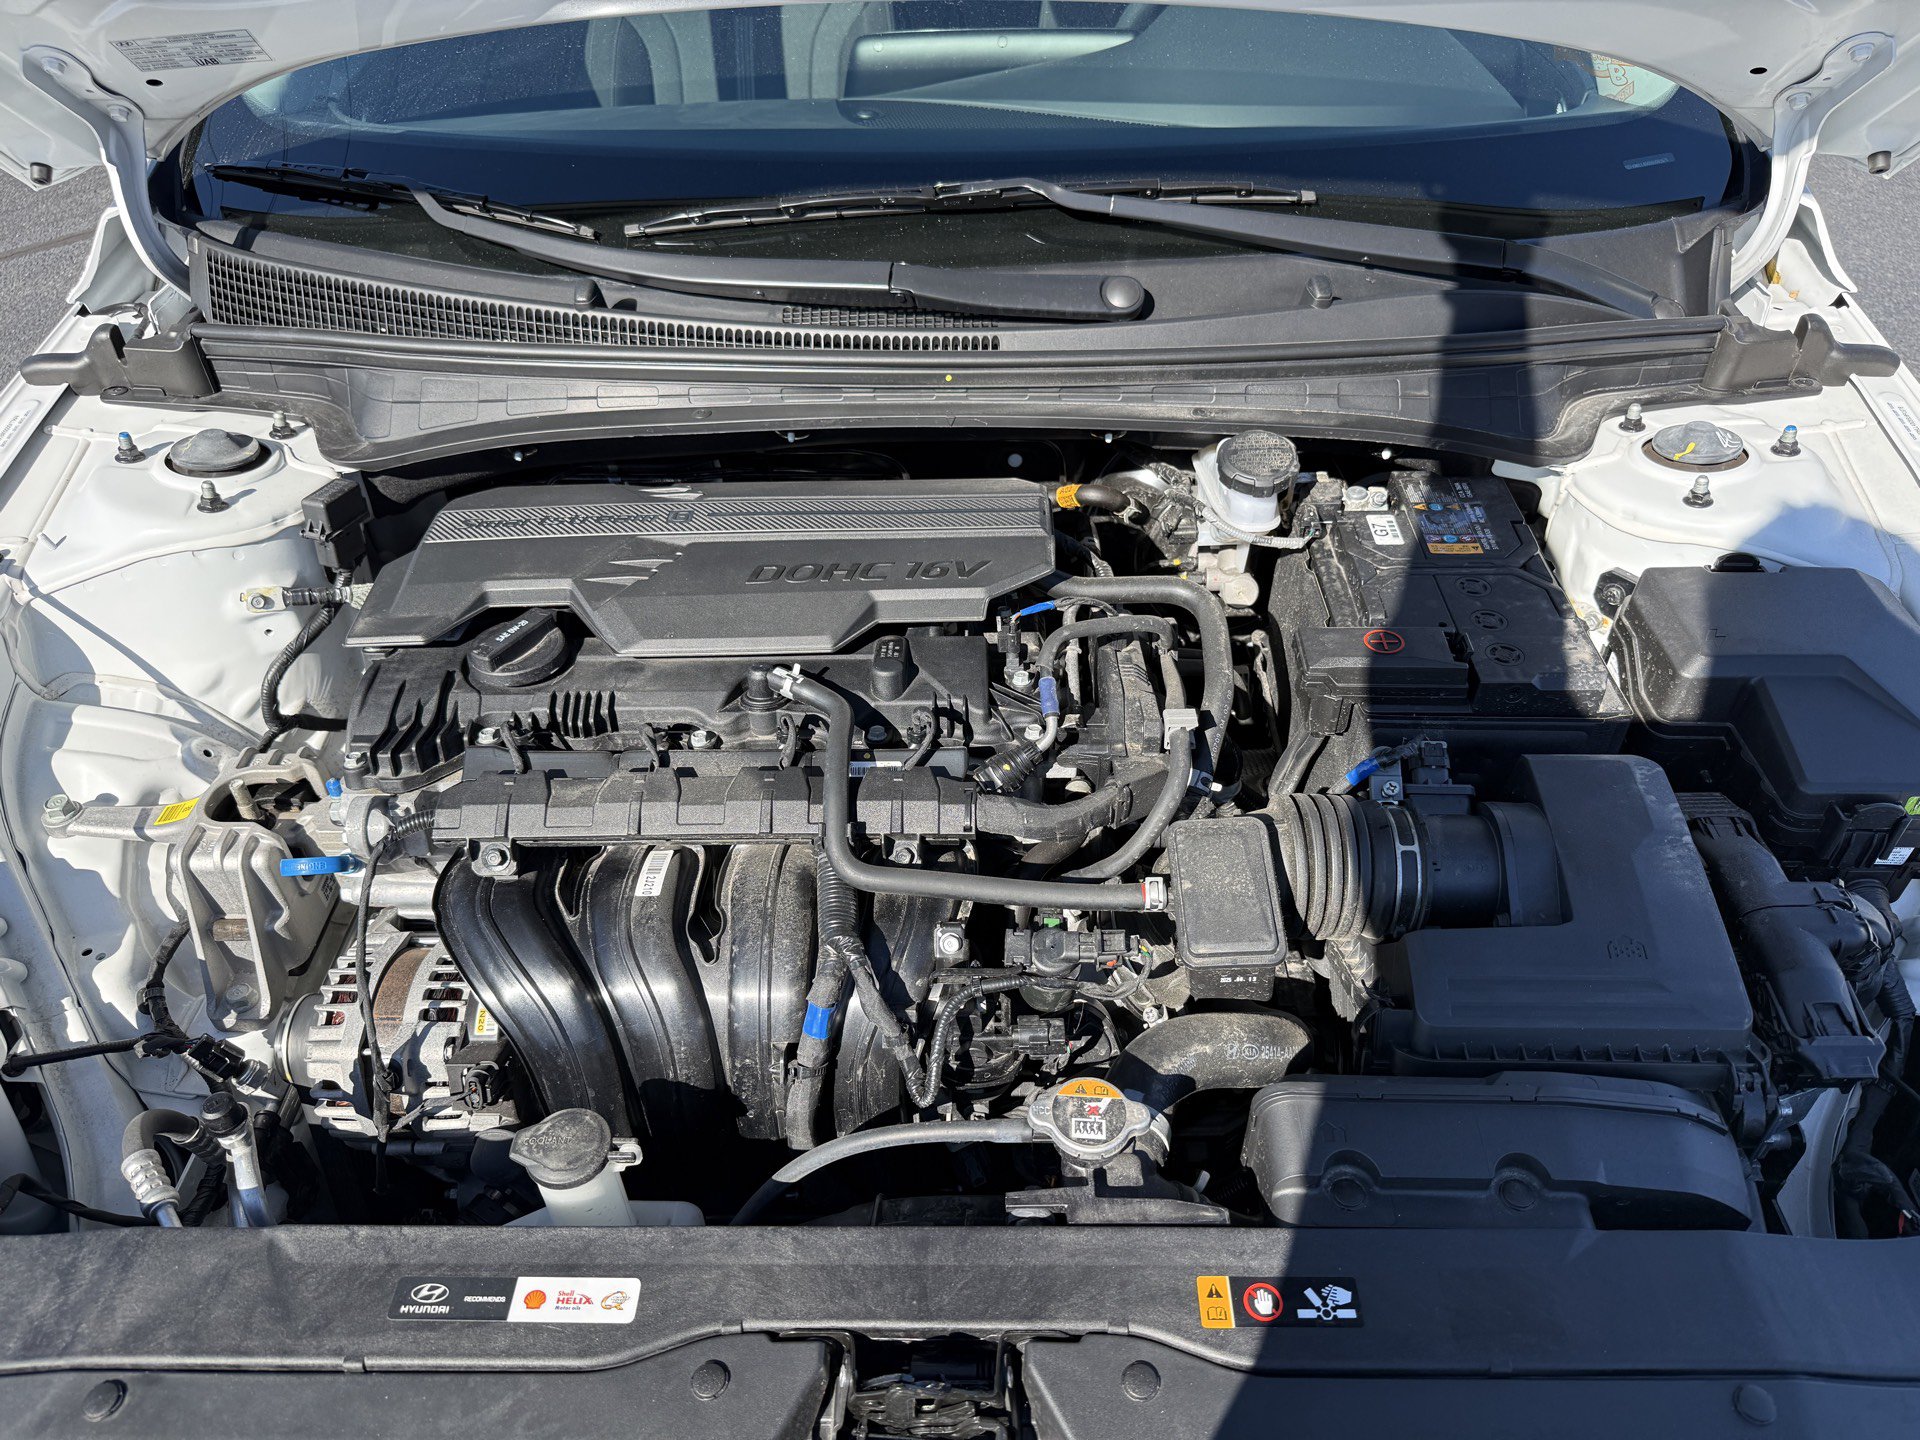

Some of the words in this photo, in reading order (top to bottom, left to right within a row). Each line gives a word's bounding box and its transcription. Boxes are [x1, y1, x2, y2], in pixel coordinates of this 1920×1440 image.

[454, 512, 660, 531] Smartstream
[1372, 523, 1390, 538] G7
[745, 562, 896, 584] DOHC
[904, 559, 993, 581] 16V
[523, 1135, 574, 1147] COOLANT
[399, 1304, 450, 1314] HYUNDAI
[463, 1295, 507, 1303] RECOMMENDS
[556, 1296, 594, 1305] HELIX
